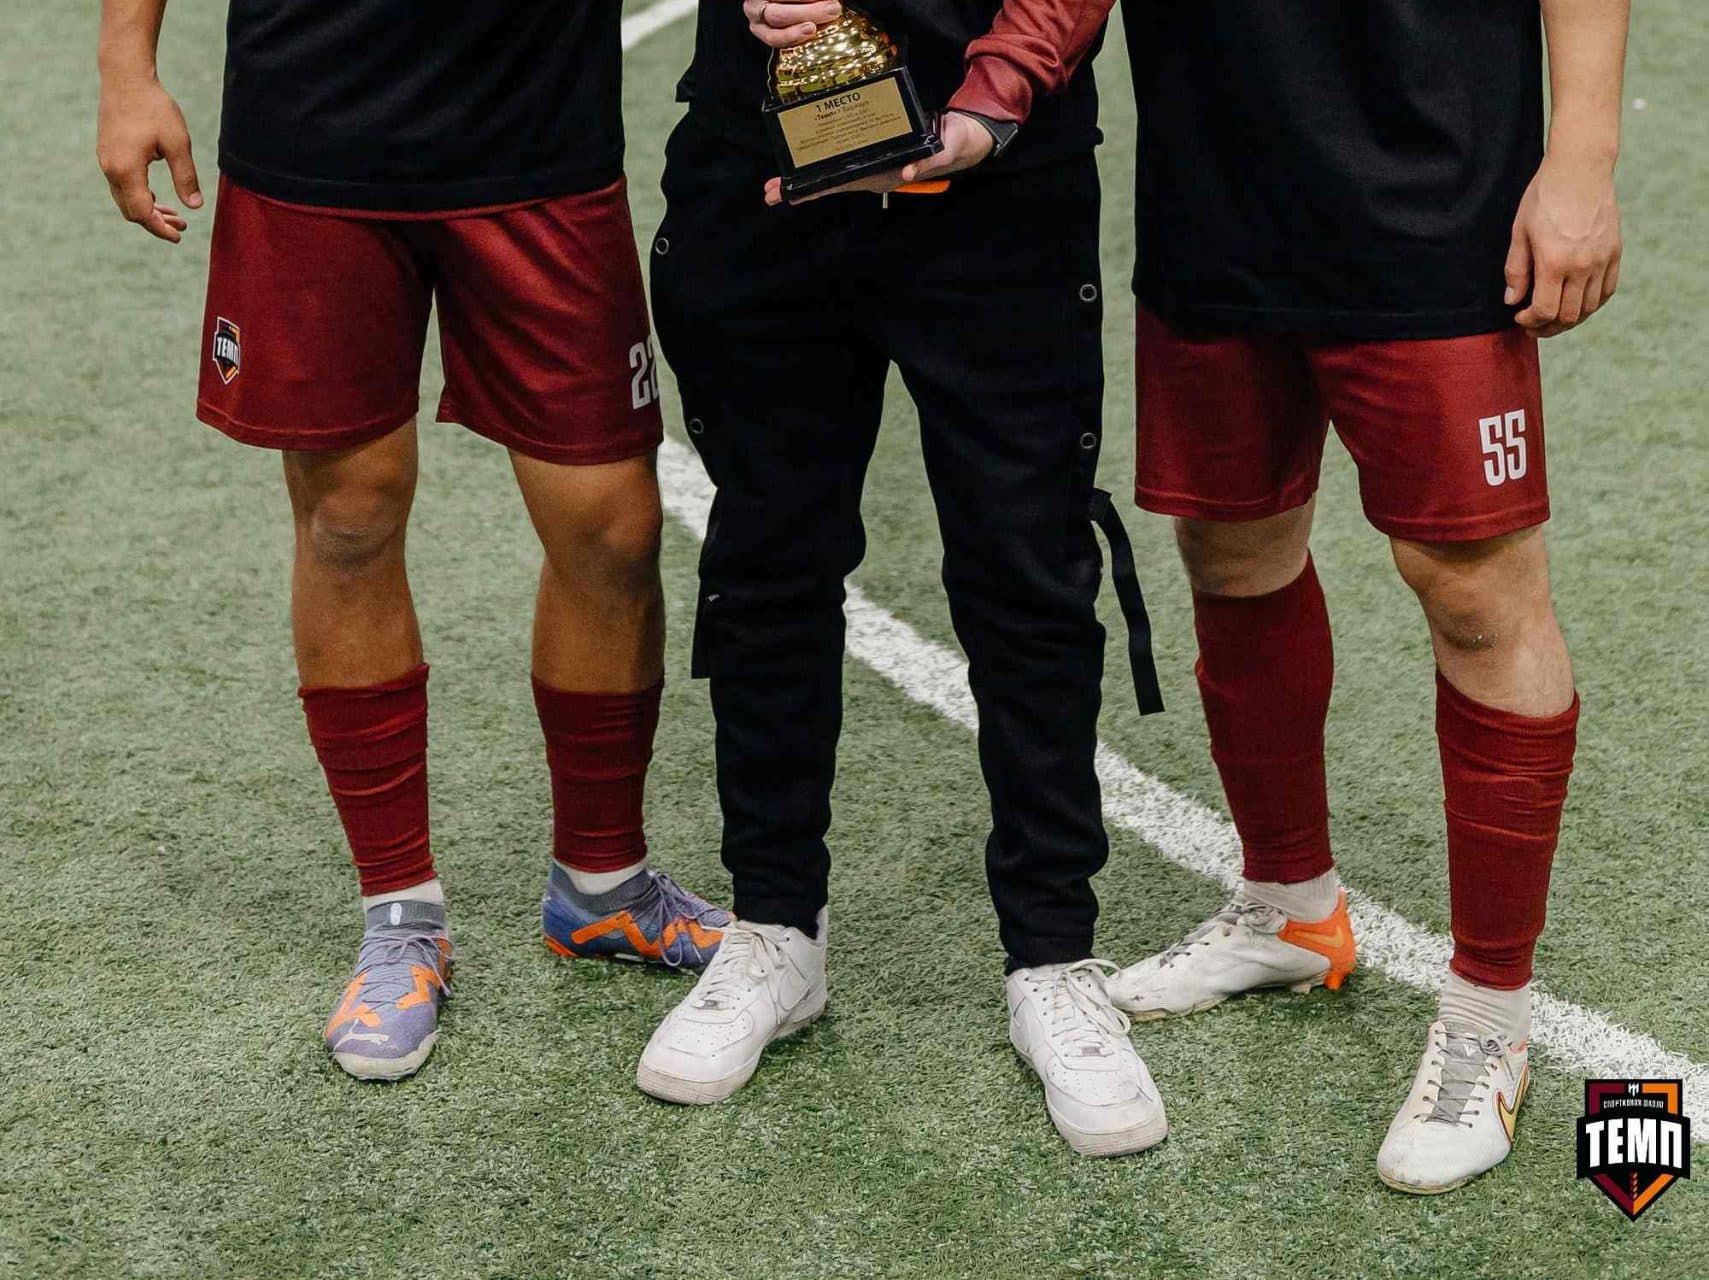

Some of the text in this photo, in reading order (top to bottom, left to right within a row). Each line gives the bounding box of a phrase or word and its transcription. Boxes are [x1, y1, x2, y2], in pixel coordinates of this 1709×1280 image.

[816, 104, 821, 112] 1
[824, 92, 861, 110] МЕСТО
[217, 336, 239, 365] ТЕМП
[1479, 409, 1527, 487] 55
